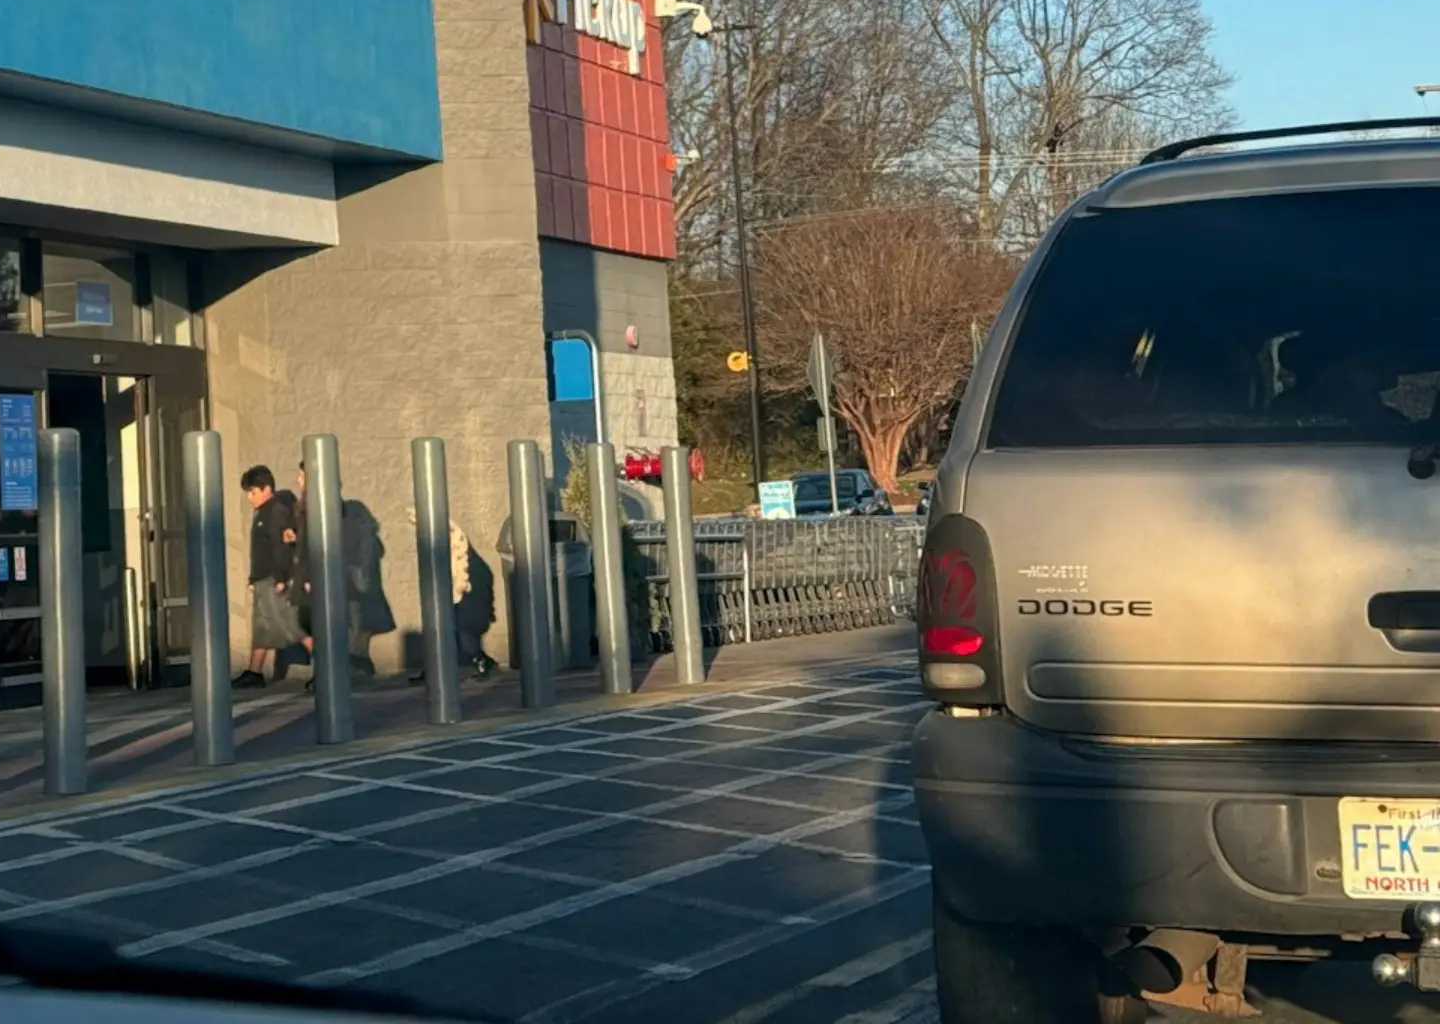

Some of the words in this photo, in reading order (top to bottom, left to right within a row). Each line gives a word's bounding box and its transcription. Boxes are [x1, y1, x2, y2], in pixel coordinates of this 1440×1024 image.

[1018, 599, 1153, 617] DODGE
[1388, 808, 1422, 821] First
[1365, 877, 1431, 893] NORTH
